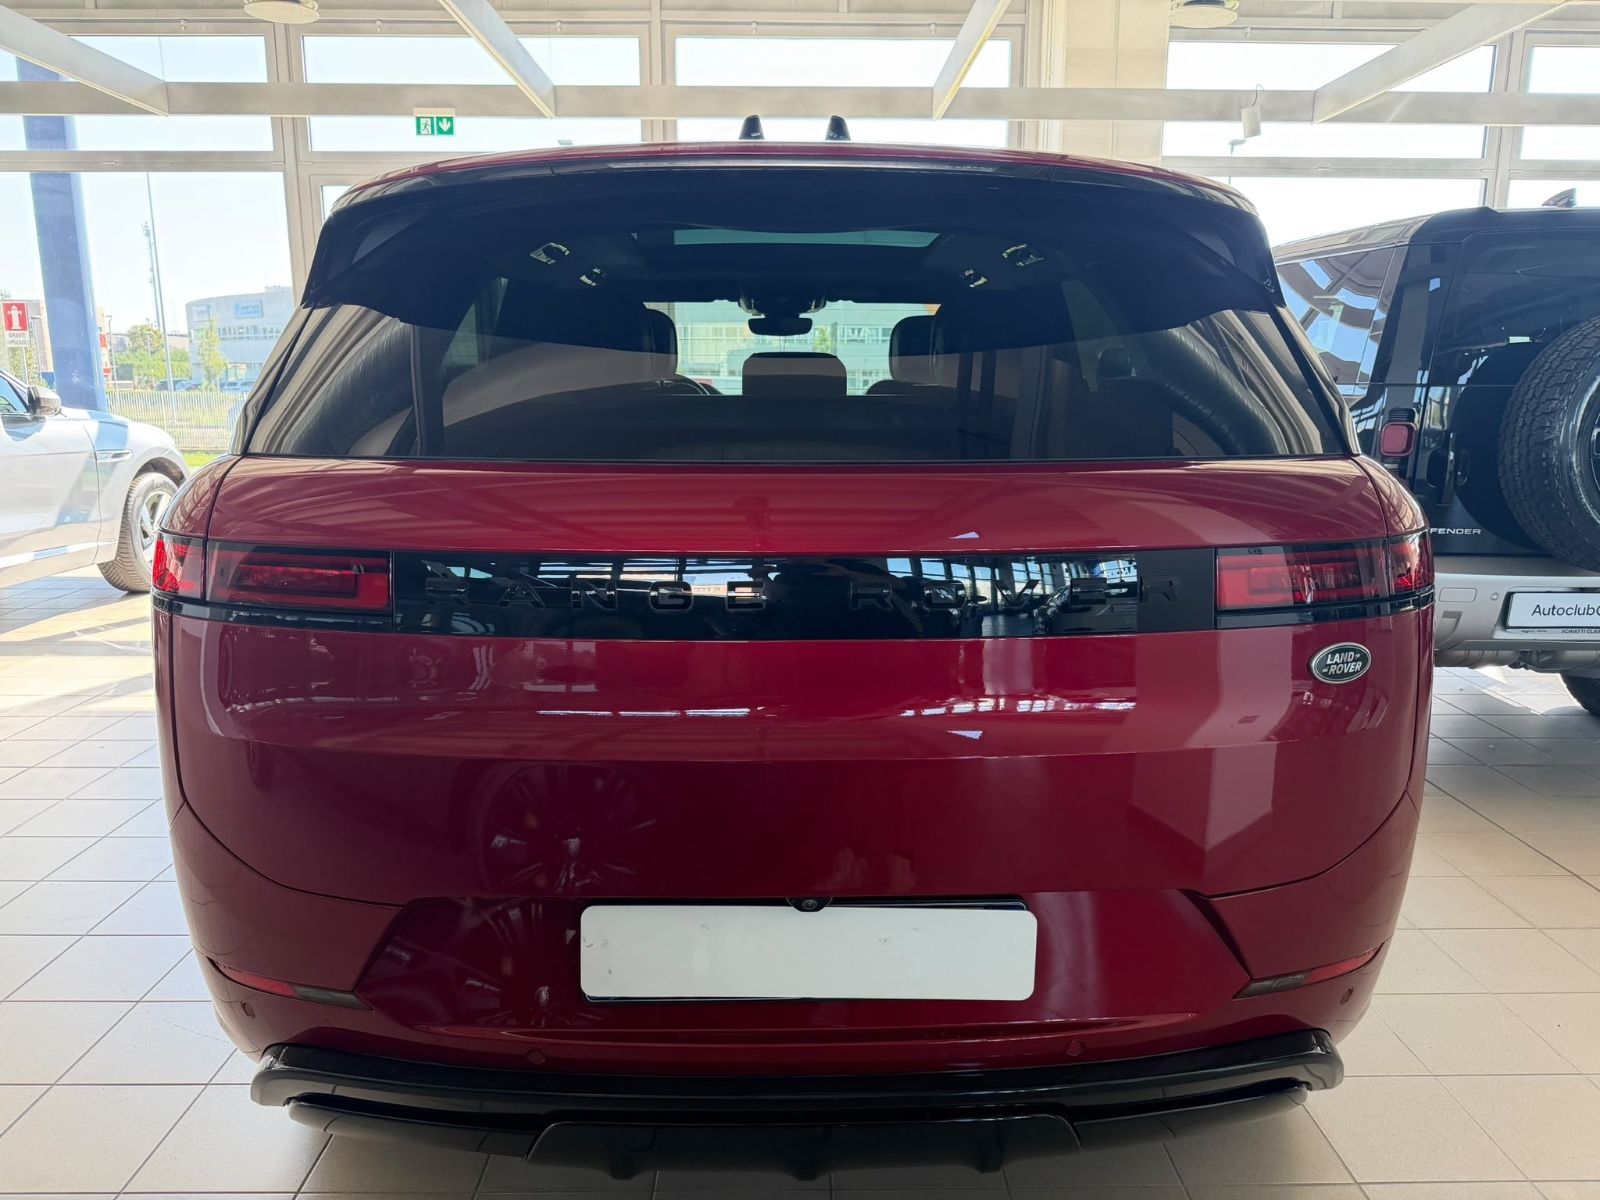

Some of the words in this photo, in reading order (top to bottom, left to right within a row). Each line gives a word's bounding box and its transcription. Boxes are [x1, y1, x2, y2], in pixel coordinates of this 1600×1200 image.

[426, 579, 769, 612] RANGE
[849, 576, 1182, 612] ROVER
[1326, 651, 1355, 665] LAND
[1328, 661, 1362, 675] ROVER
